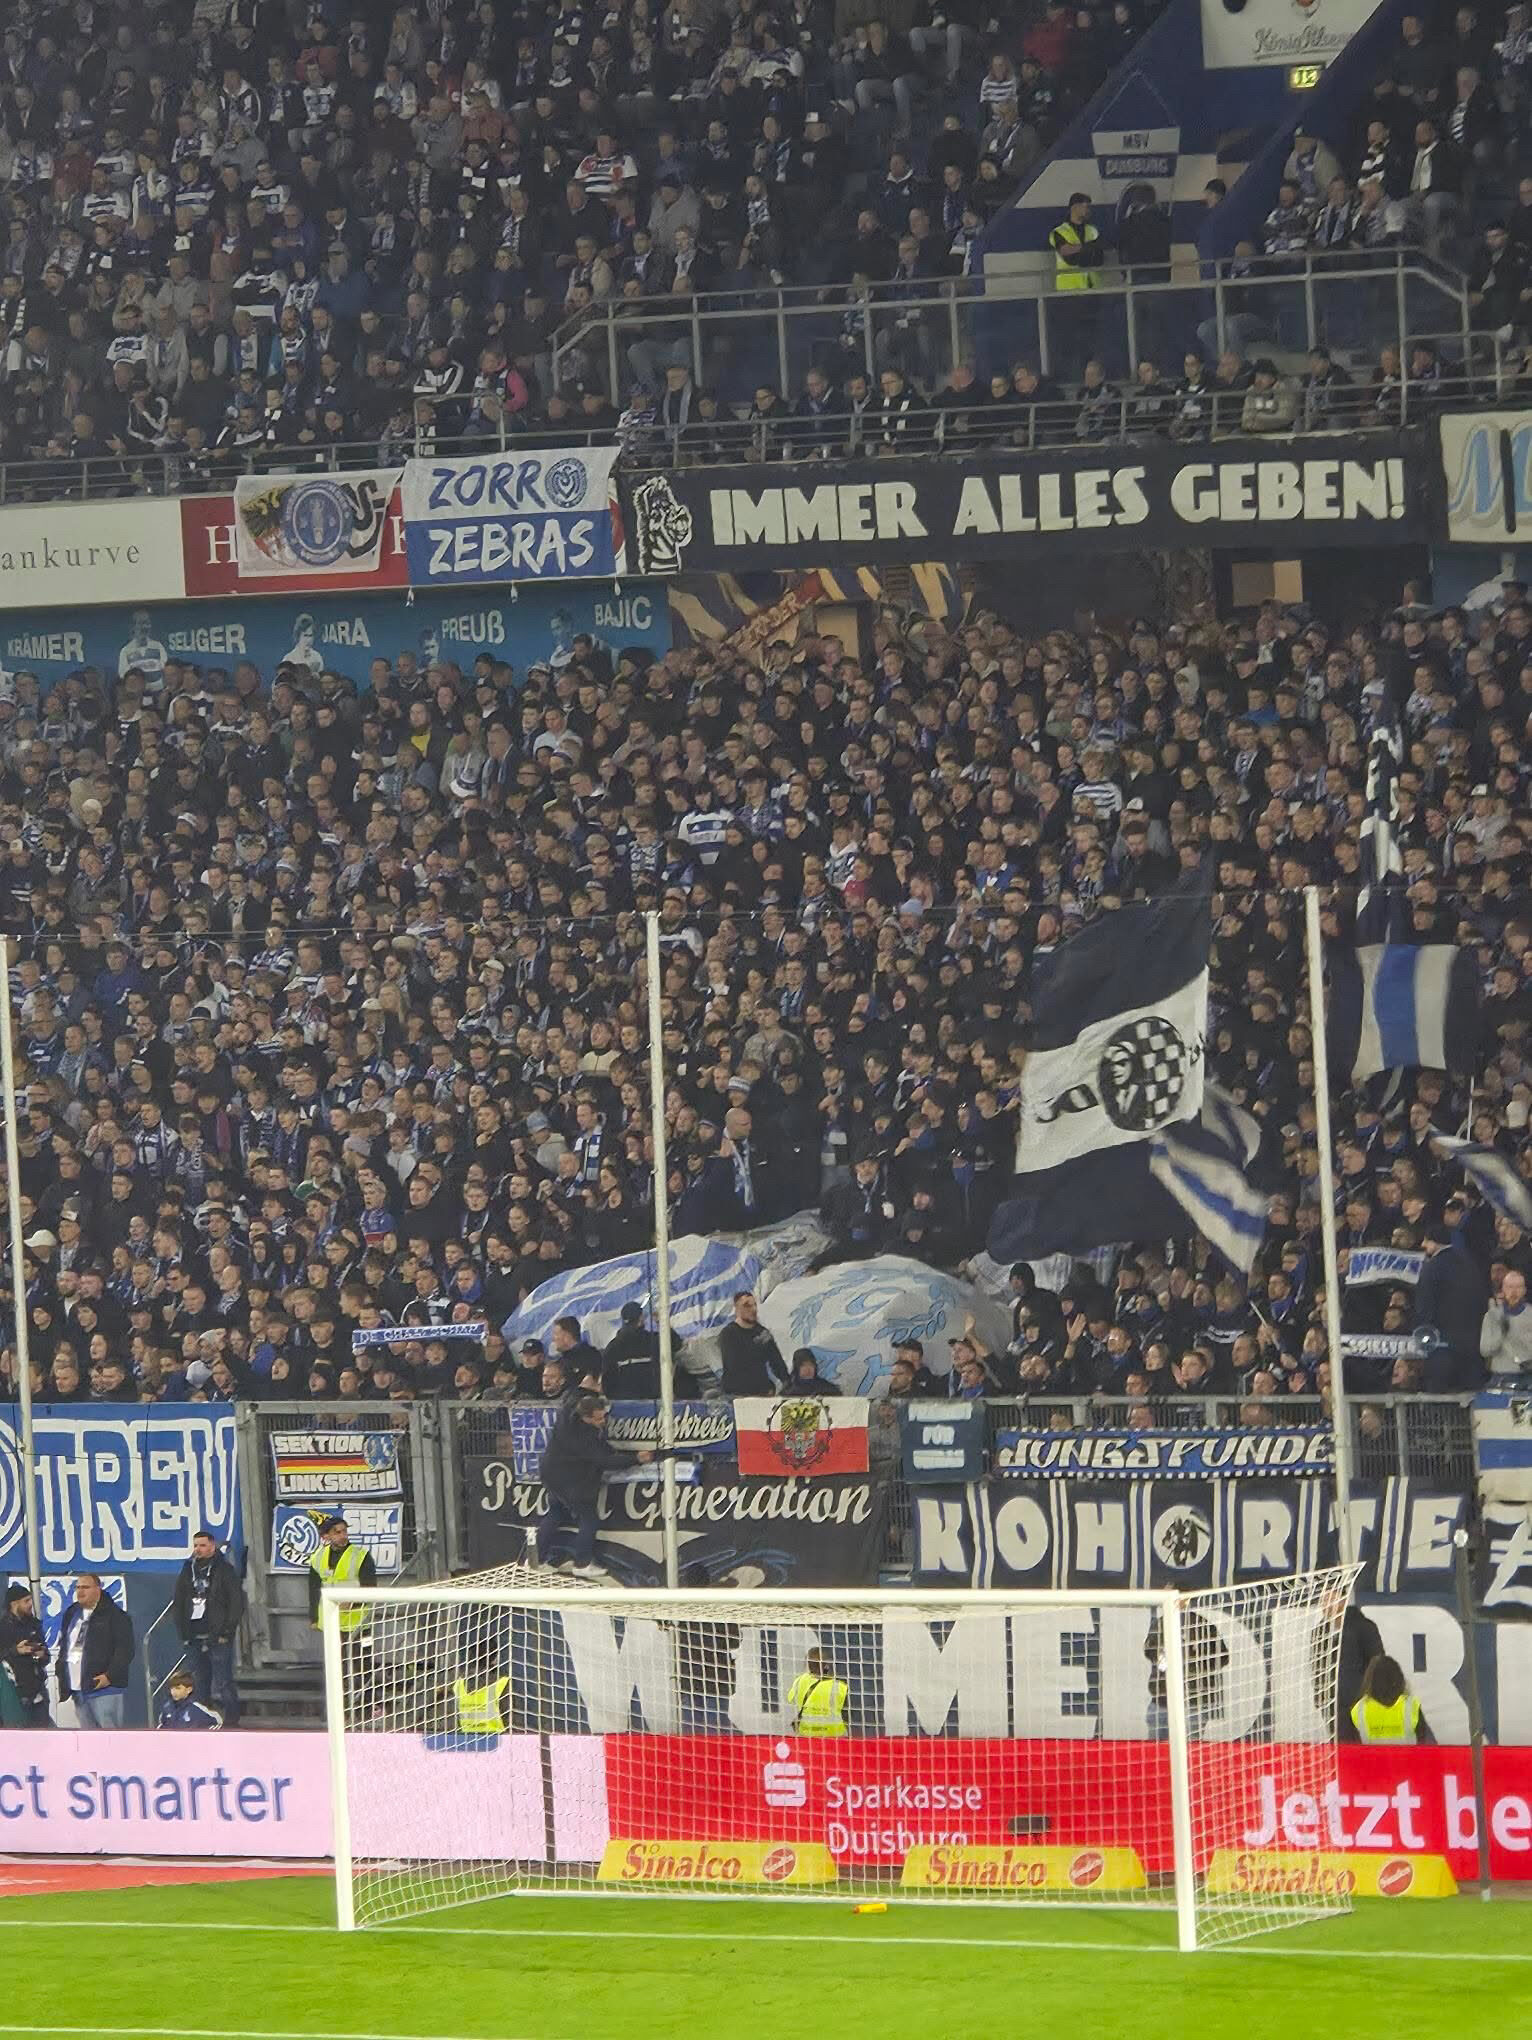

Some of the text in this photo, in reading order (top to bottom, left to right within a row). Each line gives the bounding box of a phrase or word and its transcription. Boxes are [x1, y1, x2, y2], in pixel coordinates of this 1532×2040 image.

[710, 481, 928, 546] IMMER
[952, 465, 1150, 536] ALLES
[1170, 457, 1405, 523] GEBEN!
[1, 537, 140, 570] ankurve
[428, 518, 594, 575] ZEBRAS
[322, 616, 371, 648] JARA
[594, 596, 652, 630] BAJIC
[168, 623, 246, 654] SELIGER
[274, 1434, 365, 1454] SEKTION
[279, 1469, 398, 1493] LINKSRHEIN
[67, 1767, 292, 1822] smarter
[825, 1775, 983, 1817] Sparkasse
[1243, 1774, 1425, 1849] Jetzt
[621, 1842, 743, 1880] Sinalco
[925, 1846, 1048, 1887] Sinalco
[1230, 1854, 1357, 1894] Sinalco
